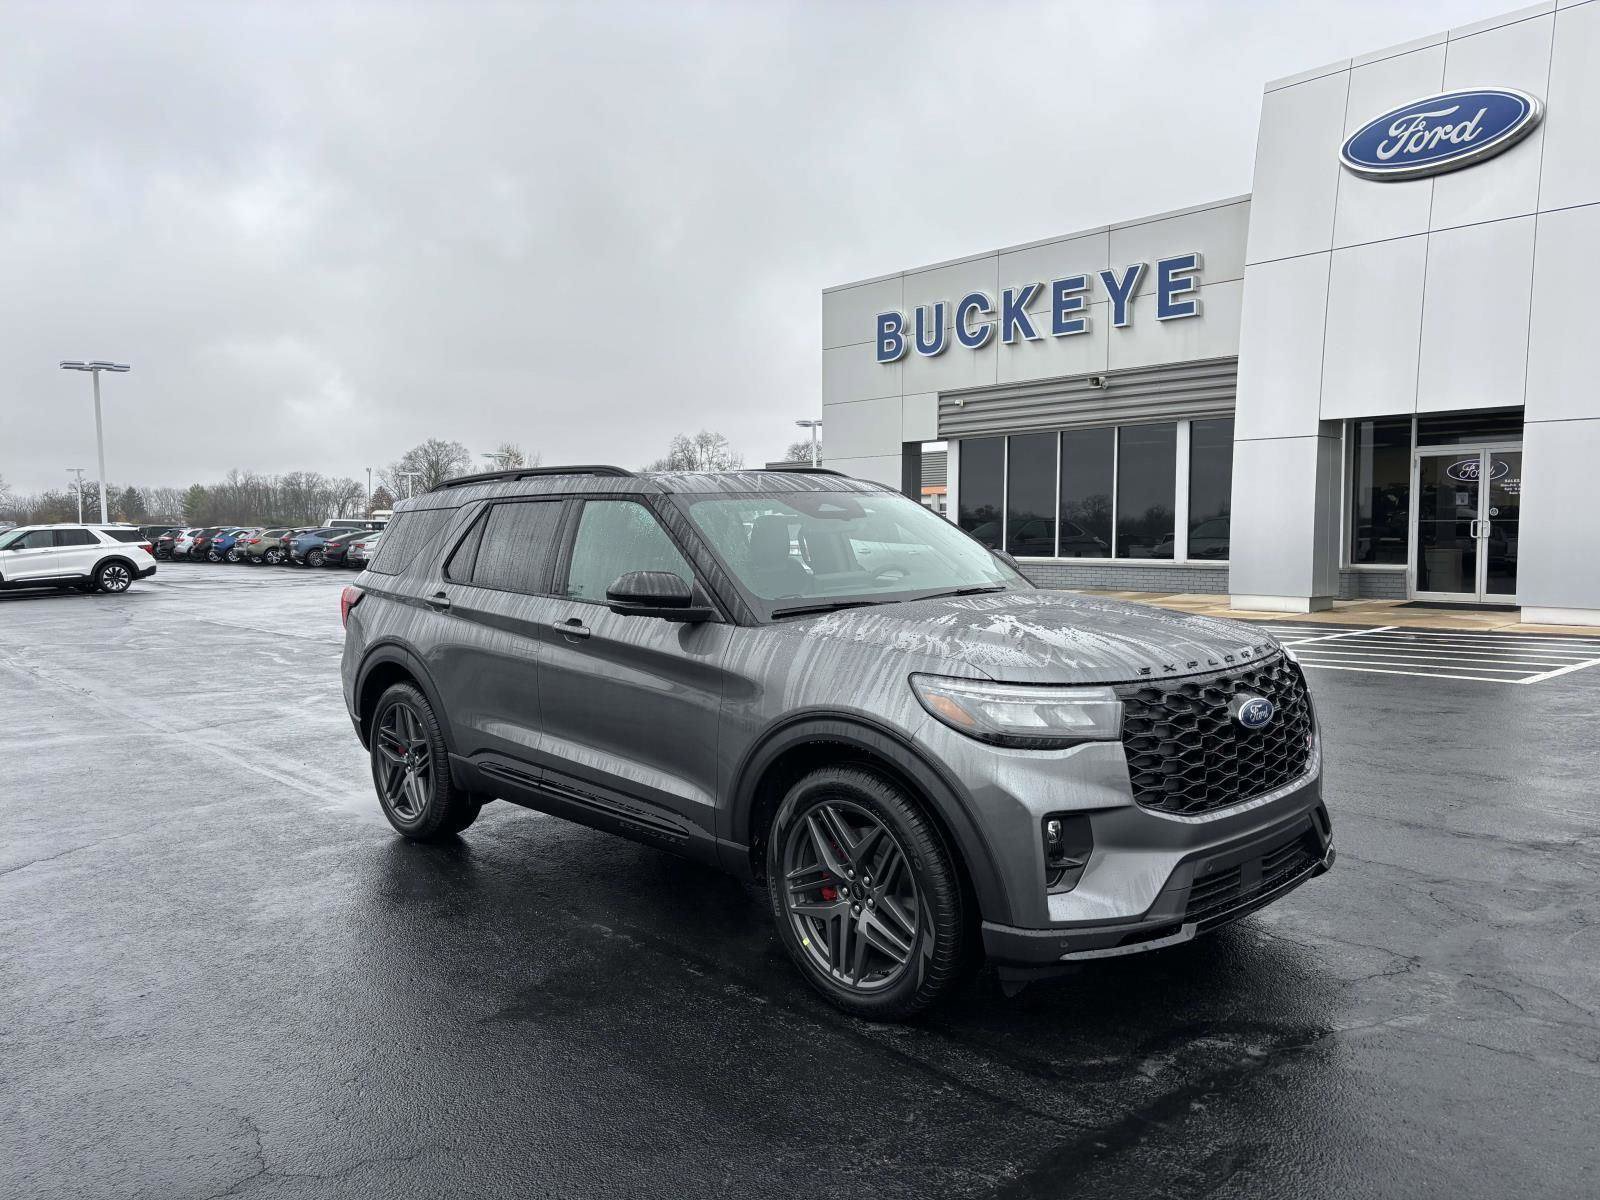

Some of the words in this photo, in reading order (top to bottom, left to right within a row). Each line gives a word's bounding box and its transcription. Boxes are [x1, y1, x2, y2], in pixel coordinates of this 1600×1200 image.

[1376, 105, 1488, 160] Ford
[876, 252, 1204, 364] BUCKEYE
[1460, 463, 1495, 478] Fo
[1138, 642, 1272, 676] EXPLORER
